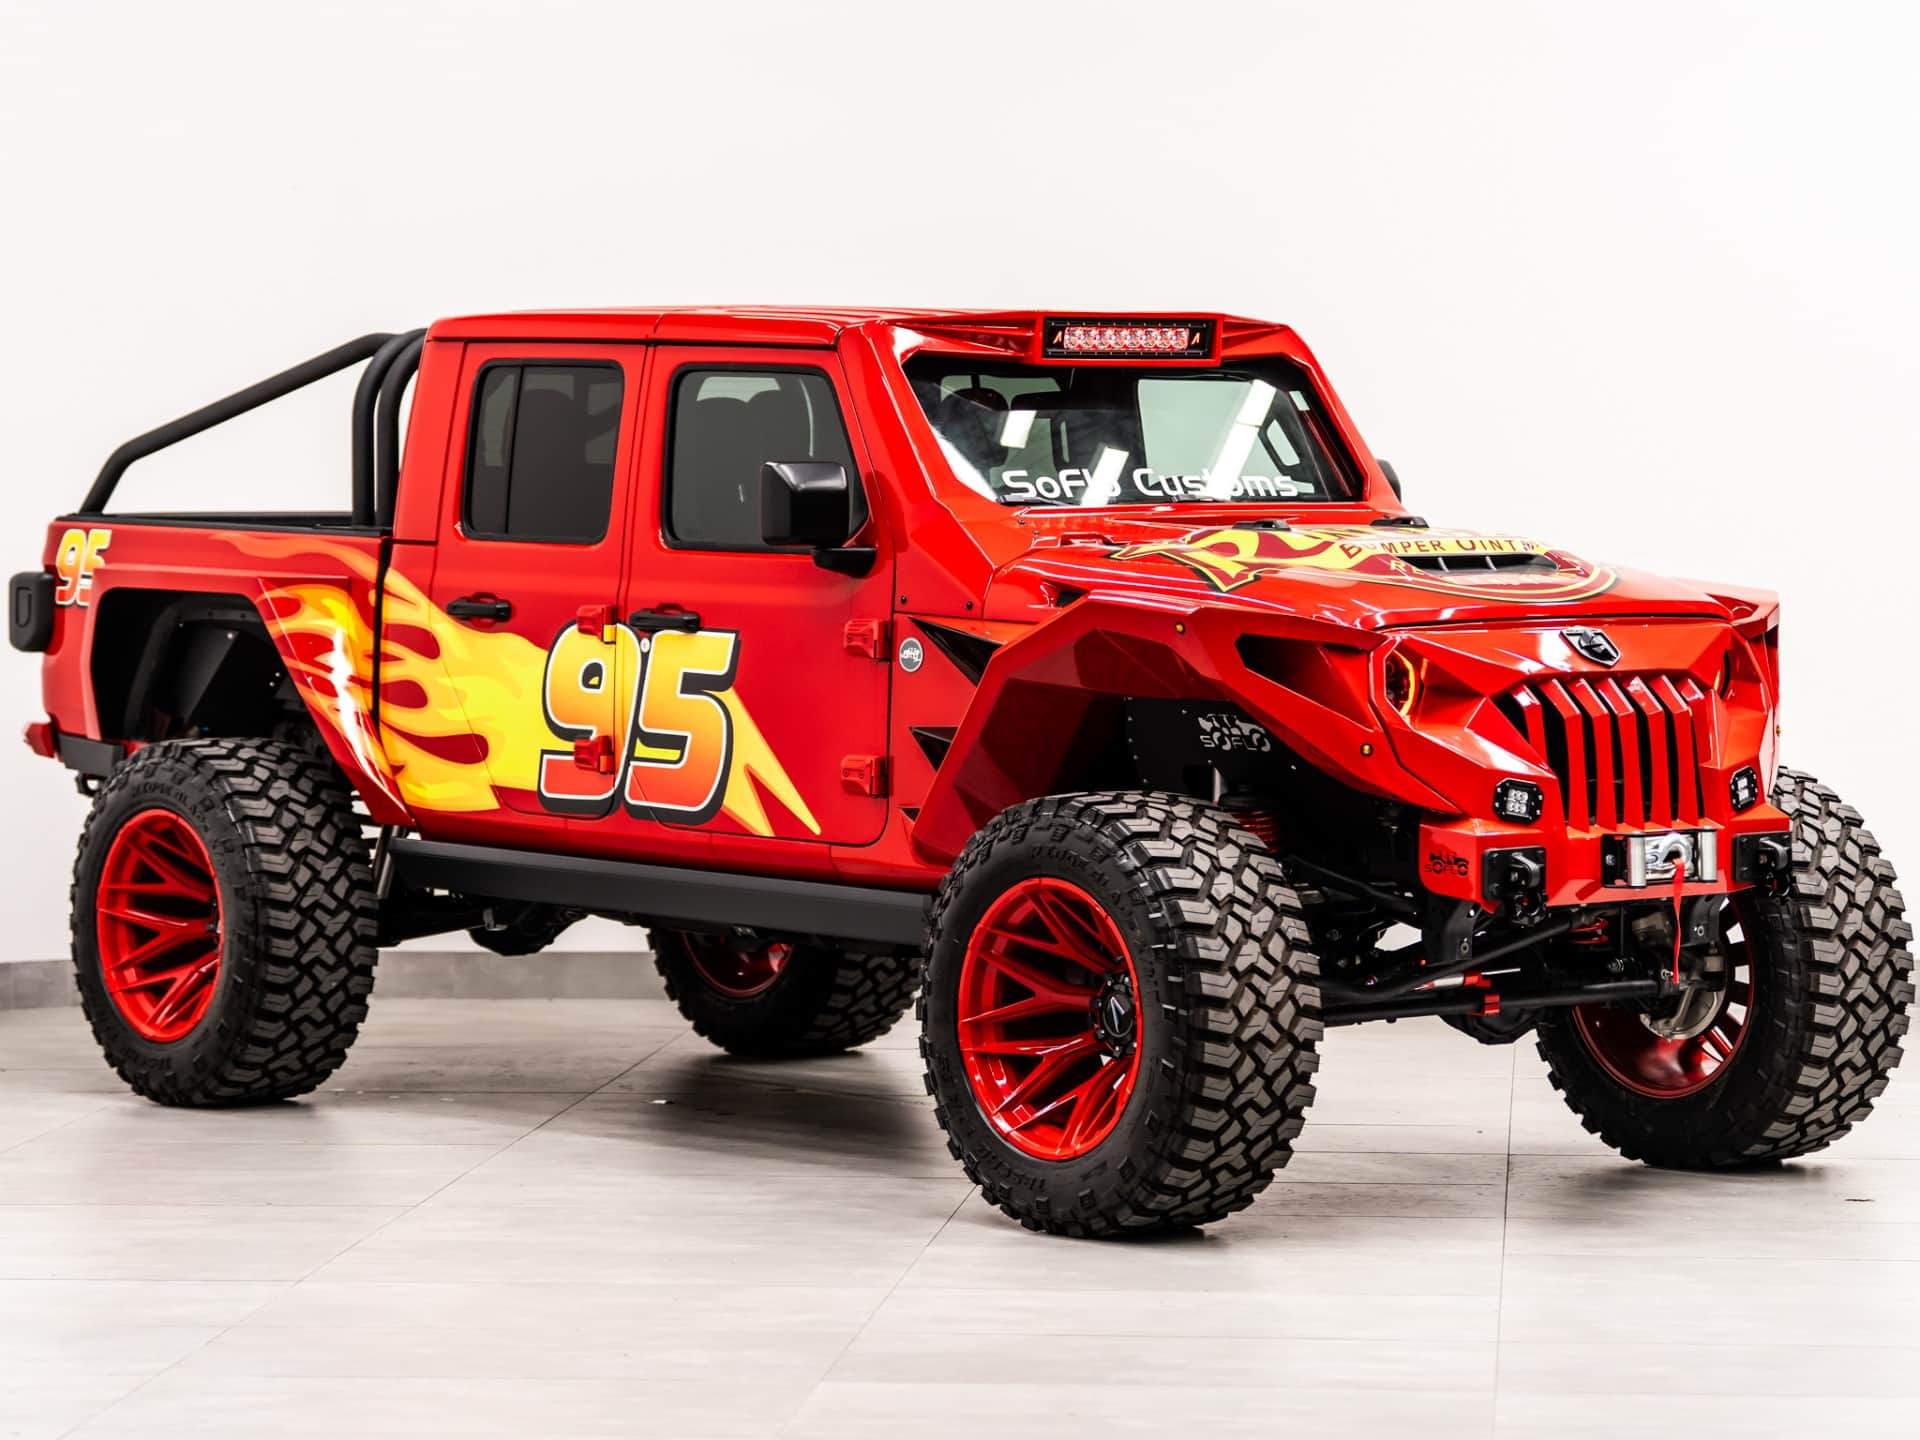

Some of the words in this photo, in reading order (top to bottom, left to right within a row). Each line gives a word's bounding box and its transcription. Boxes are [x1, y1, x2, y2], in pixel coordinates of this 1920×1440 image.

[55, 528, 112, 608] 95
[1339, 539, 1446, 559] BUMPER
[537, 620, 741, 825] 95
[1200, 731, 1271, 752] SOFLO
